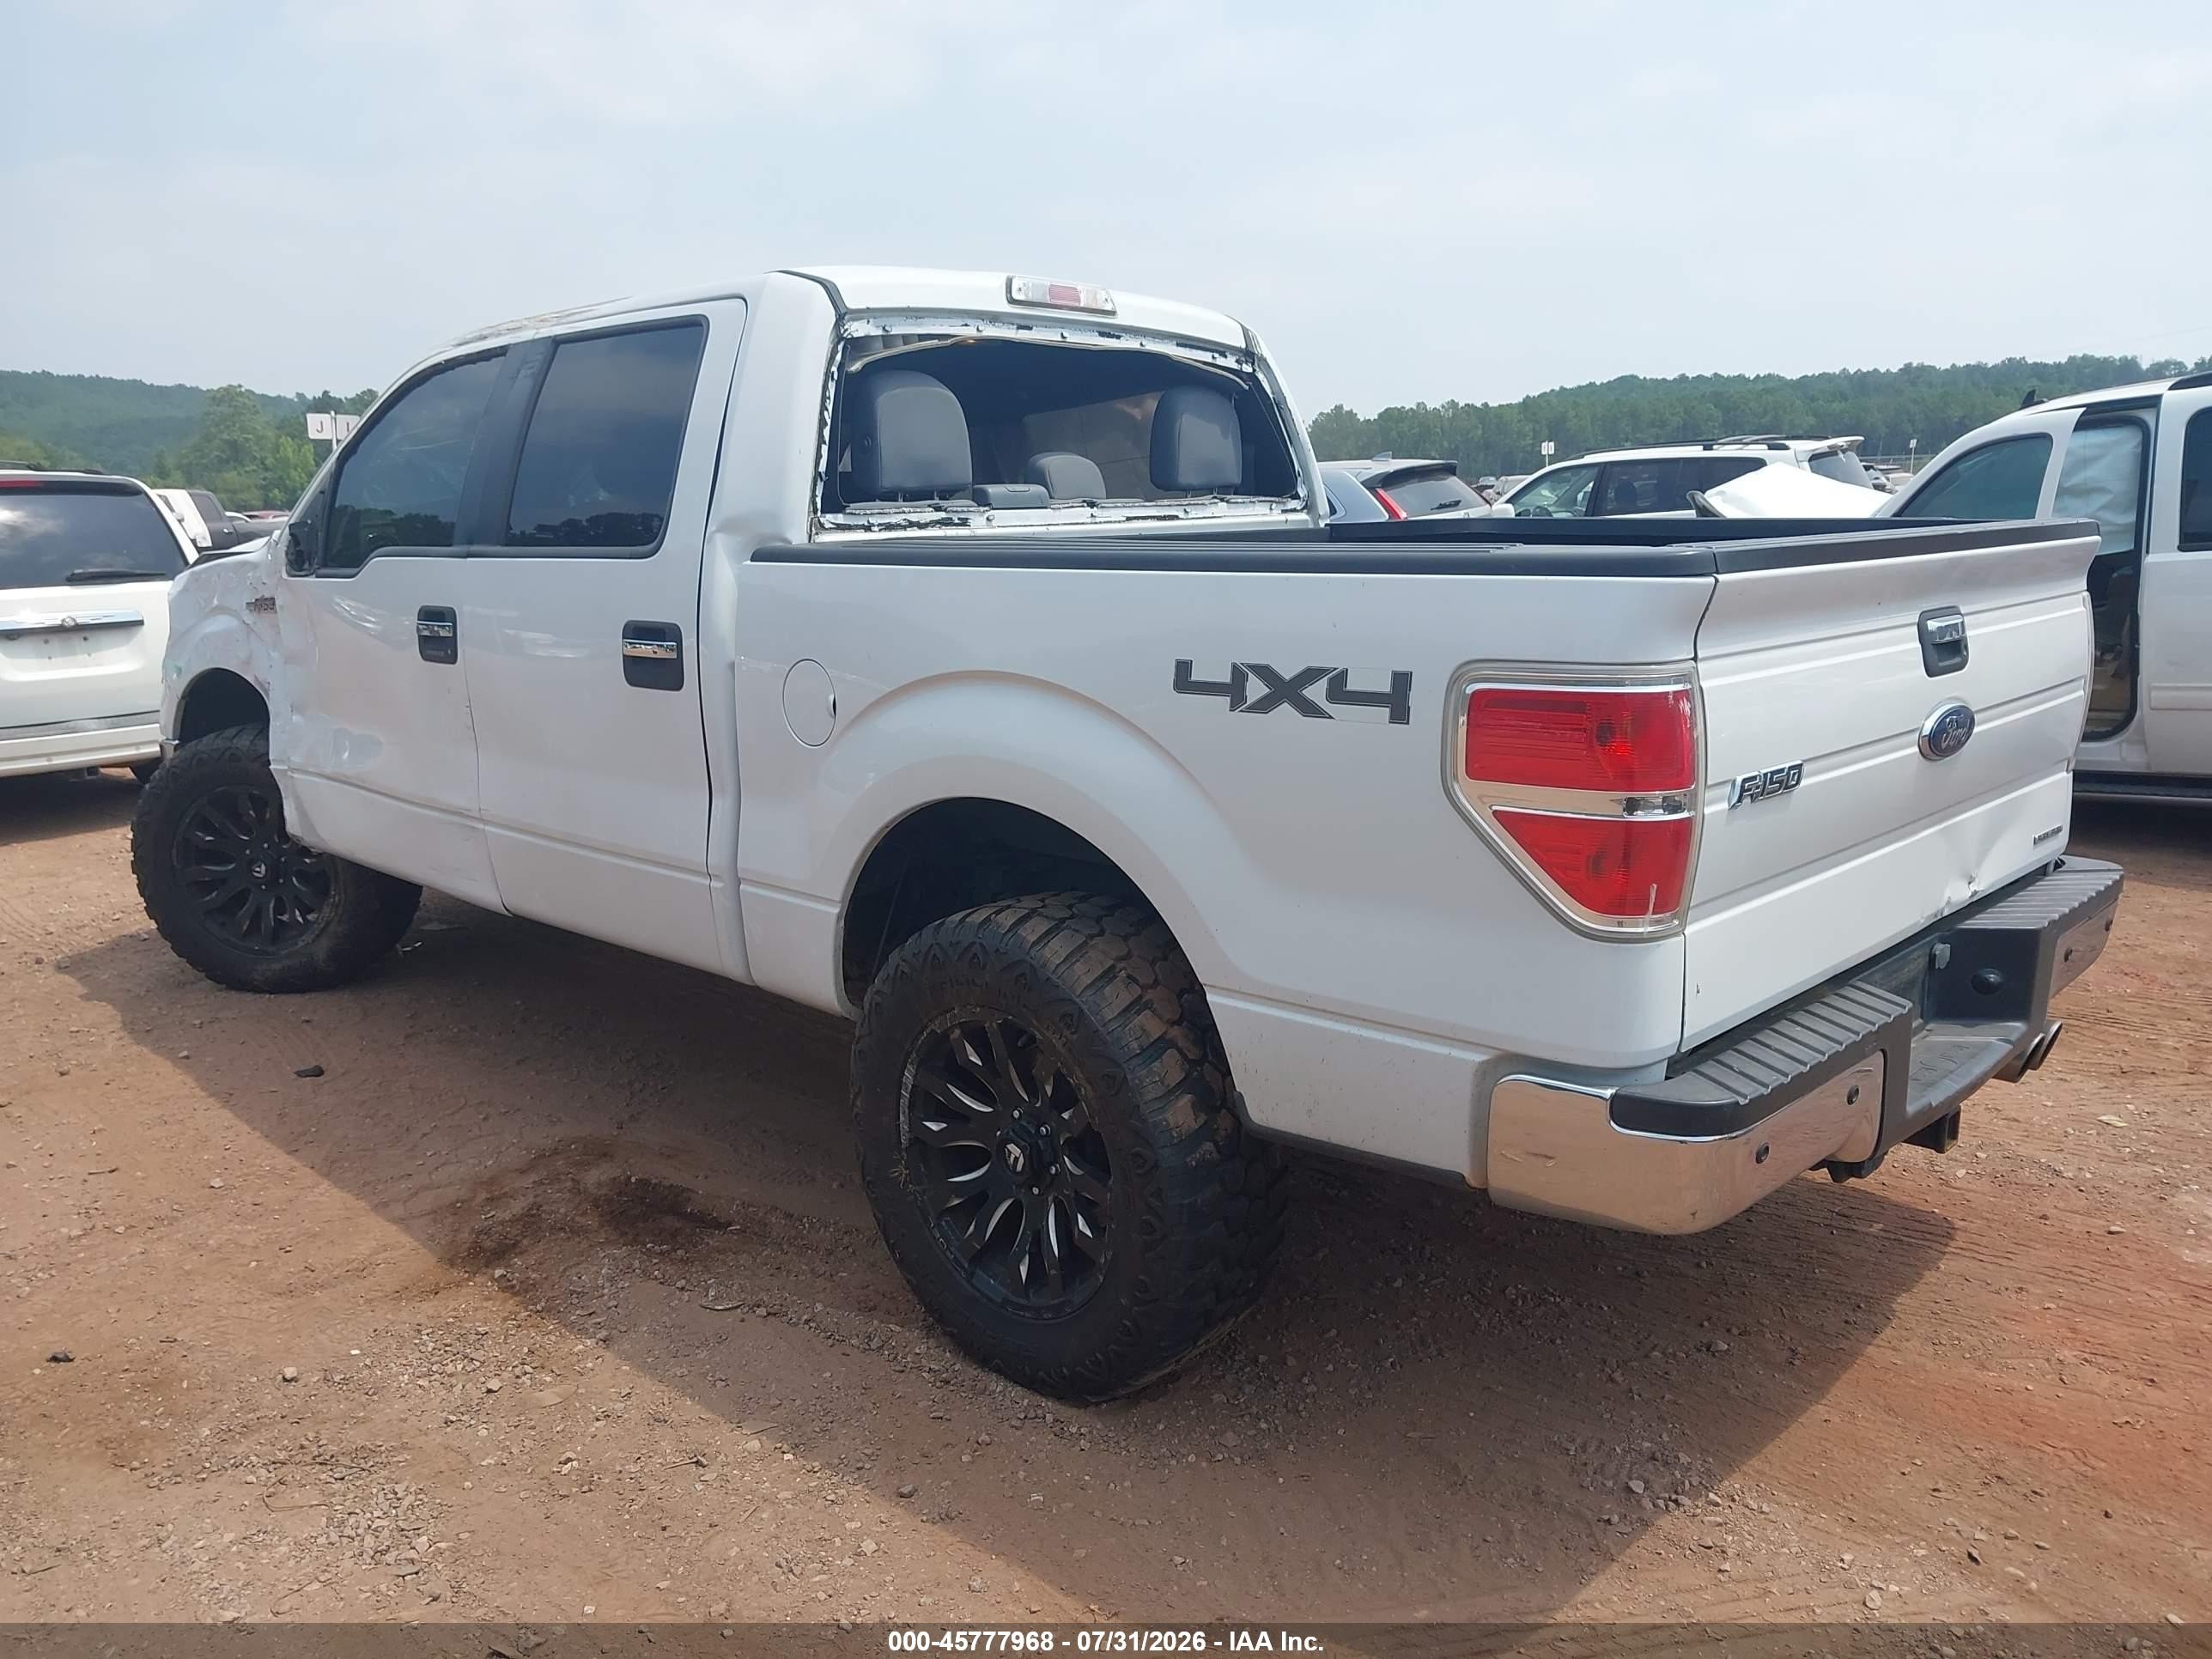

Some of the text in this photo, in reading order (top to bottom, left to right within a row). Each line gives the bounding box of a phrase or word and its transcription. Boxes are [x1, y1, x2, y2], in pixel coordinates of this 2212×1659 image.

[316, 419, 324, 434] J
[1173, 659, 1413, 725] 4X4
[1941, 714, 1972, 750] Ford
